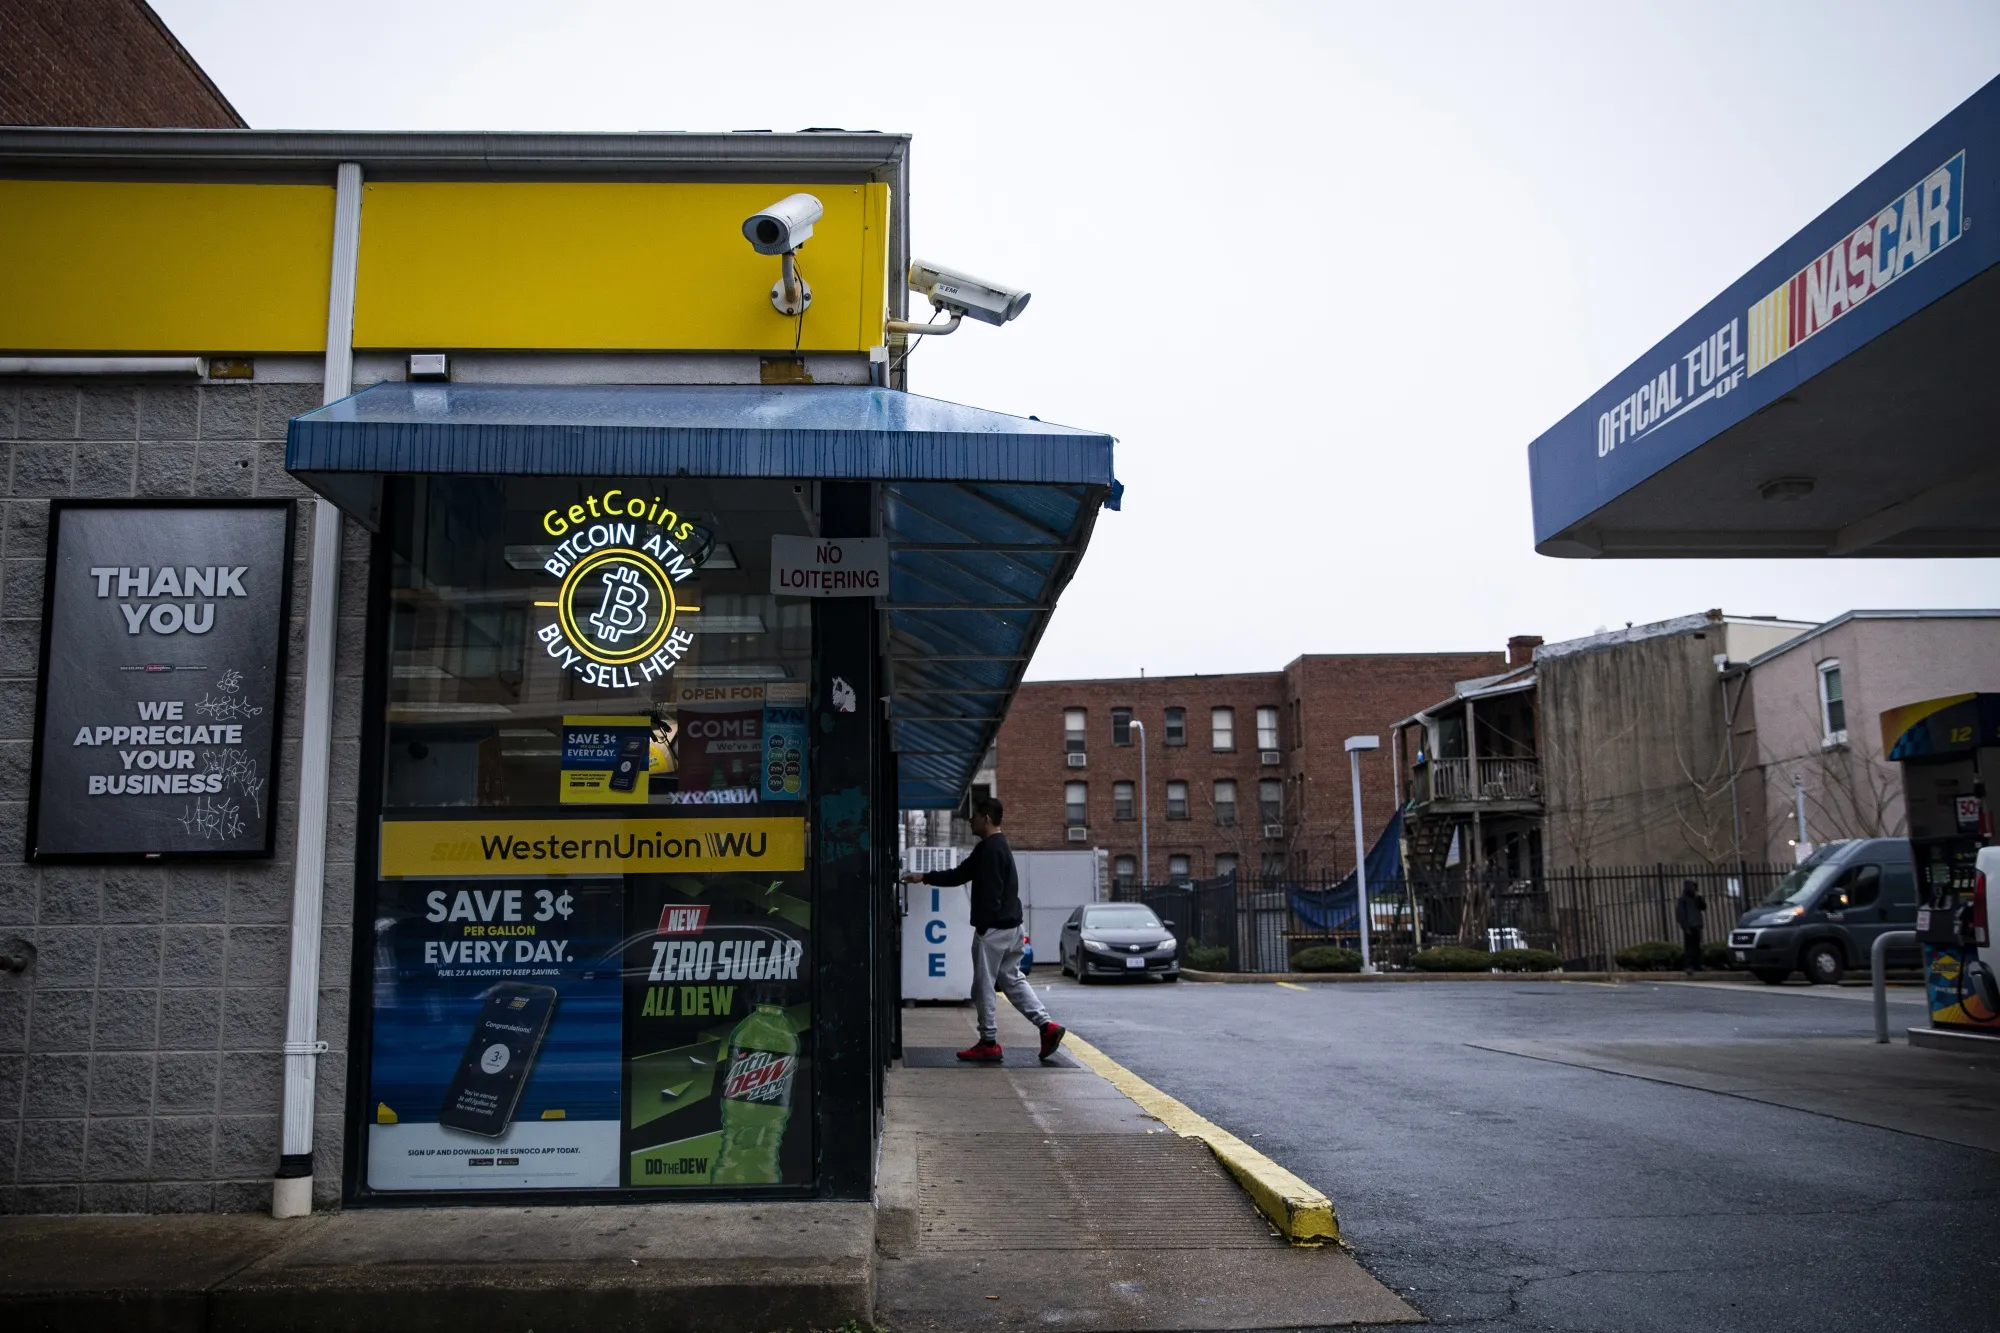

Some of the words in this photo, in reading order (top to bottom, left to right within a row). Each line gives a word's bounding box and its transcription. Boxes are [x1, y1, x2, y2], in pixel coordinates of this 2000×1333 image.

[1805, 167, 1951, 336] NASCAR
[1598, 363, 1683, 458] OFFICIAL
[1682, 317, 1745, 397] FUEL
[1714, 367, 1745, 399] OF
[543, 489, 695, 542] GetCoins
[544, 522, 636, 579] BITCOIN
[642, 534, 694, 583] ATM
[817, 545, 843, 564] NO
[90, 566, 249, 598] THANK
[779, 569, 880, 590] LOITERING
[120, 603, 215, 635] YOU
[537, 622, 640, 689] BUY-SELL
[639, 625, 694, 683] HERE
[681, 687, 723, 700] OPEN
[730, 686, 764, 699] FOR
[138, 701, 184, 721] WE
[766, 709, 804, 724] ZYN
[73, 724, 243, 746] APPRECIATE
[568, 733, 600, 744] SAVE
[602, 734, 617, 745] 3¢
[687, 718, 756, 739] COME
[1951, 726, 1973, 742] 12
[567, 749, 596, 757] EVERY
[596, 749, 616, 757] DAY.
[717, 742, 748, 751] We've
[119, 750, 196, 770] YOUR
[88, 774, 223, 796] BUSINESS
[481, 831, 701, 860] WesternUnion
[716, 832, 767, 857] WU
[425, 889, 522, 923] SAVE
[533, 889, 575, 922] 3¢
[463, 925, 486, 936] PER
[487, 925, 536, 936] GALLON
[667, 909, 701, 932] NEW
[424, 941, 510, 965] EVERY
[515, 940, 574, 964] DAY.
[647, 941, 716, 982] ZERO
[718, 939, 802, 981] SUGAR
[437, 969, 455, 977] FUEL
[455, 969, 465, 977] 2X
[465, 969, 472, 977] A
[472, 969, 501, 977] MONTH
[512, 968, 531, 976] KEEP
[531, 968, 561, 976] SAVING.
[642, 986, 677, 1017] ALL
[680, 985, 734, 1016] DEW
[485, 1020, 533, 1034] Congratulations!
[407, 1149, 425, 1157] SIGN
[436, 1148, 452, 1156] AND
[452, 1148, 495, 1156] DOWNLOAD
[541, 1147, 555, 1155] APP
